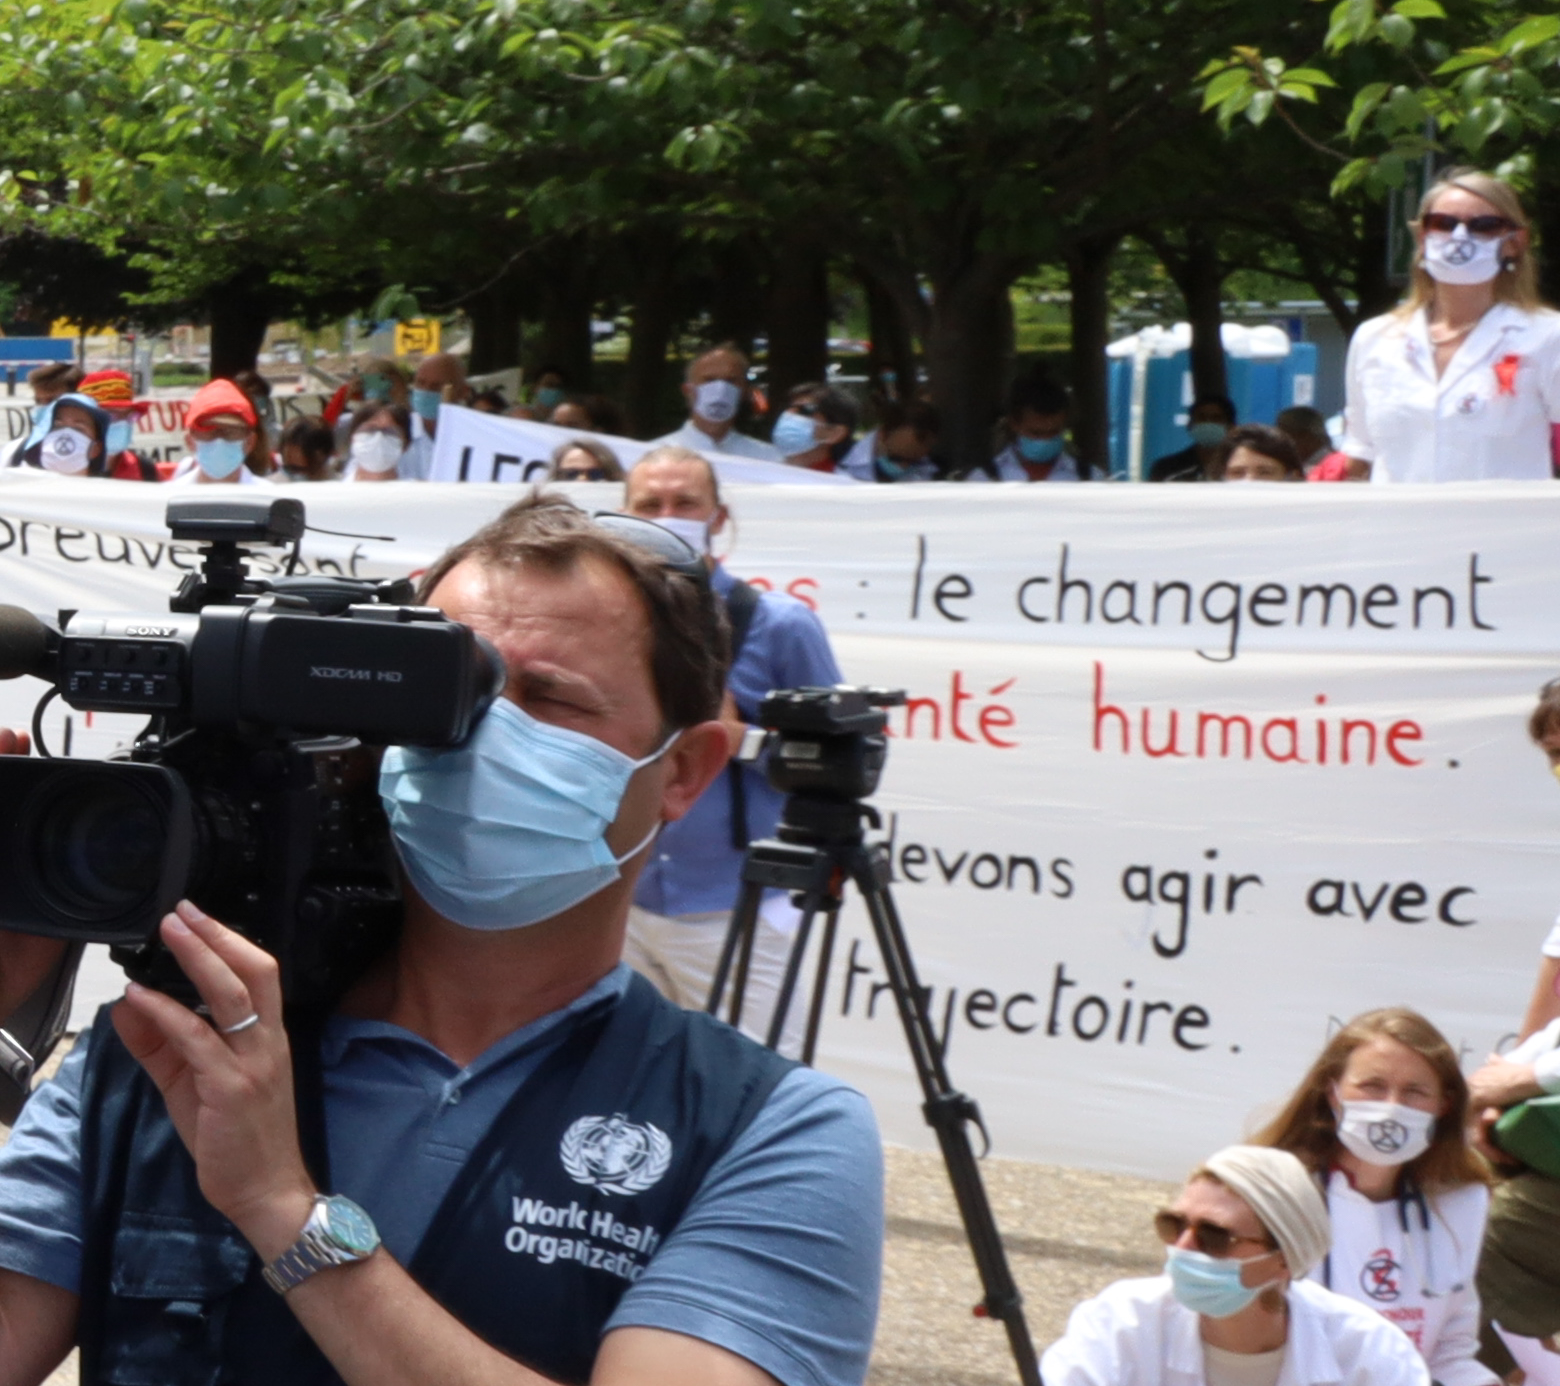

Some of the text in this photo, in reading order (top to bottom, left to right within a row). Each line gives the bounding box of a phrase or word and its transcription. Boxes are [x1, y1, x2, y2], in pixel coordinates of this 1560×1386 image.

[125, 625, 177, 637] SONY
[910, 533, 974, 623] le
[1016, 542, 1498, 662] changement
[310, 665, 403, 684] XDCAM HD
[882, 670, 1021, 749] nté
[879, 811, 1075, 900] devons
[1121, 848, 1265, 959] agir
[1305, 879, 1479, 928] avec
[841, 938, 1241, 1063] trjectoire.
[504, 1225, 646, 1283] Organizatio
[590, 1210, 660, 1255] Healt
